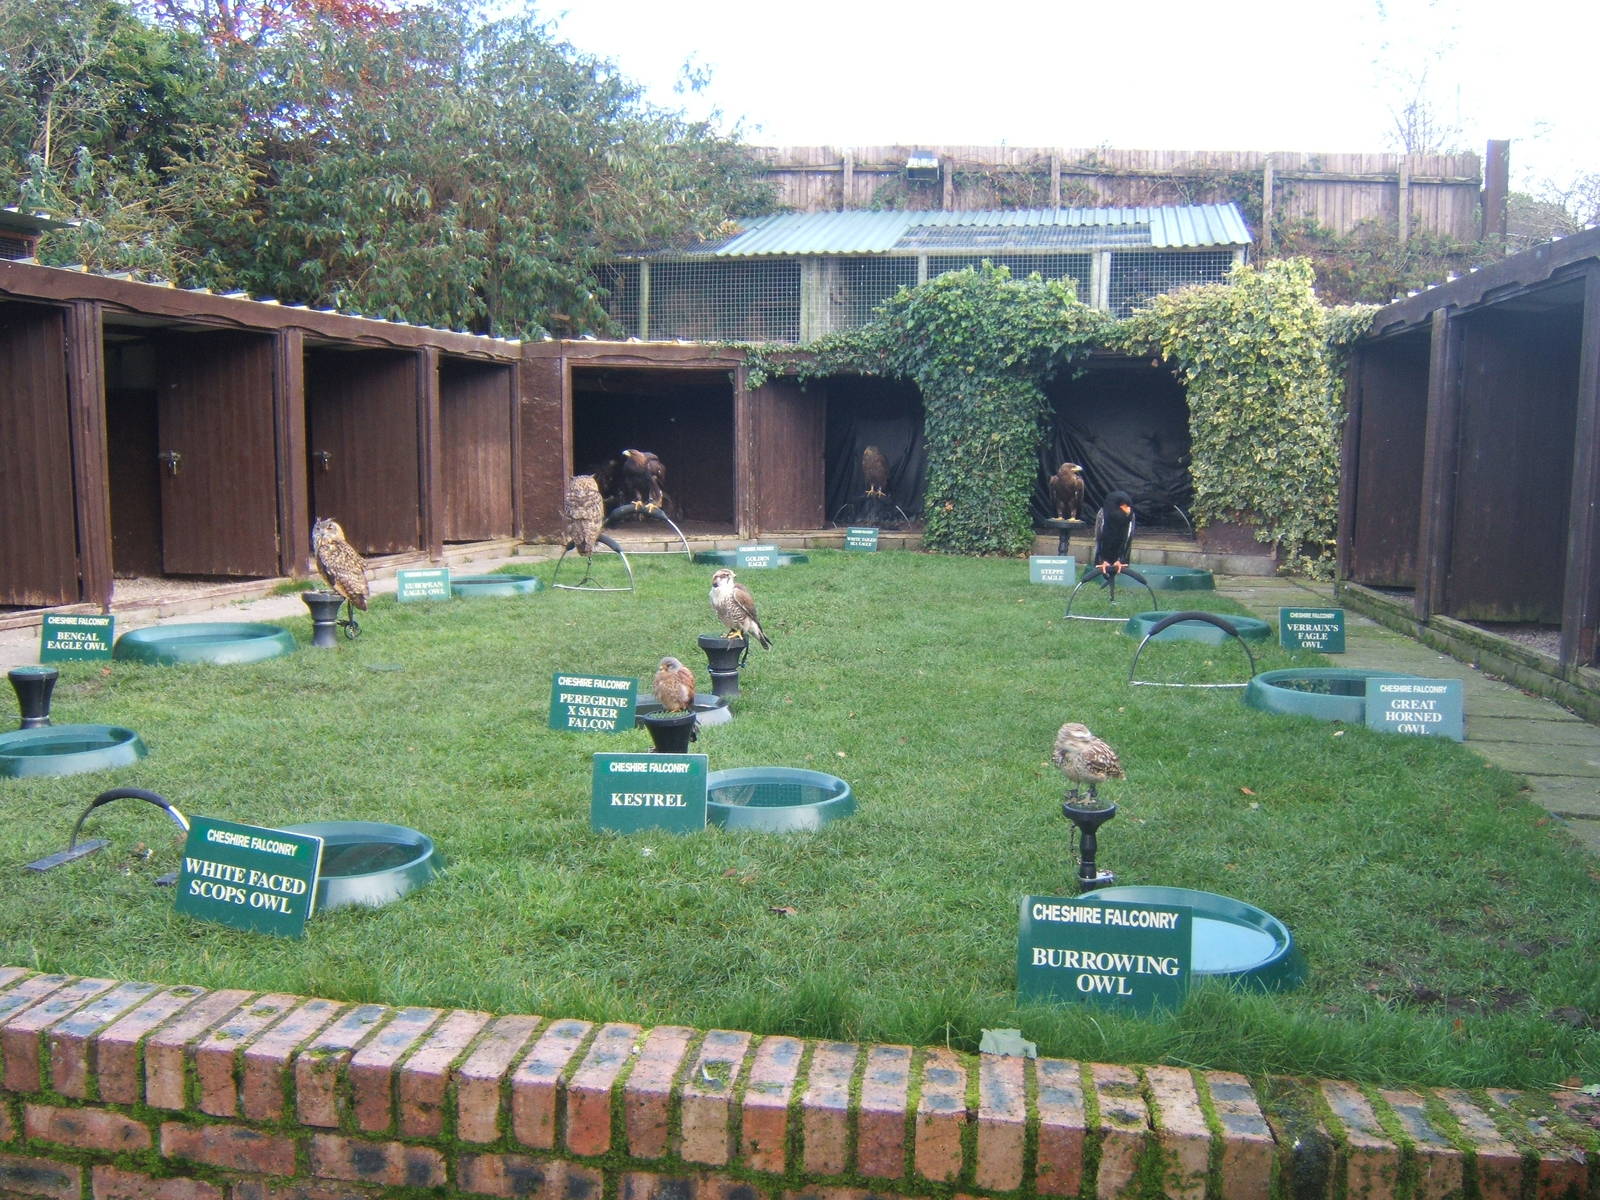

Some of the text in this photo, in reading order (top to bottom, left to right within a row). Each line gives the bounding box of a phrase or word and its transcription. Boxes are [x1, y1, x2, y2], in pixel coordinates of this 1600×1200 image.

[47, 616, 110, 626] CHESHIRE FALCONRY
[1287, 623, 1339, 632] VERRAUX'S
[57, 631, 100, 641] BENGAL
[47, 640, 108, 651] EAGLE OWL
[1301, 641, 1324, 649] OWL
[558, 676, 632, 691] CHESHIRE FALCONRY
[1380, 684, 1447, 694] CHESHIRE FALCONRY
[560, 693, 629, 708] PEREGRINE
[1391, 700, 1437, 710] GREAT
[567, 705, 618, 719] X SAKER
[1385, 711, 1442, 723] HORNED
[568, 717, 616, 730] FALCON
[1397, 723, 1430, 735] OWL
[609, 761, 690, 774] CHESHIRE FALCONRY
[610, 793, 687, 807] KESTREL
[206, 829, 299, 857] CHESHIRE FALCONRY
[186, 857, 306, 895] WHITE FACED
[189, 879, 292, 914] SCOPS OWL
[1032, 903, 1179, 930] CHESHIRE FALCONRY
[1031, 947, 1181, 977] BURROWING
[1076, 973, 1133, 996] OWL
